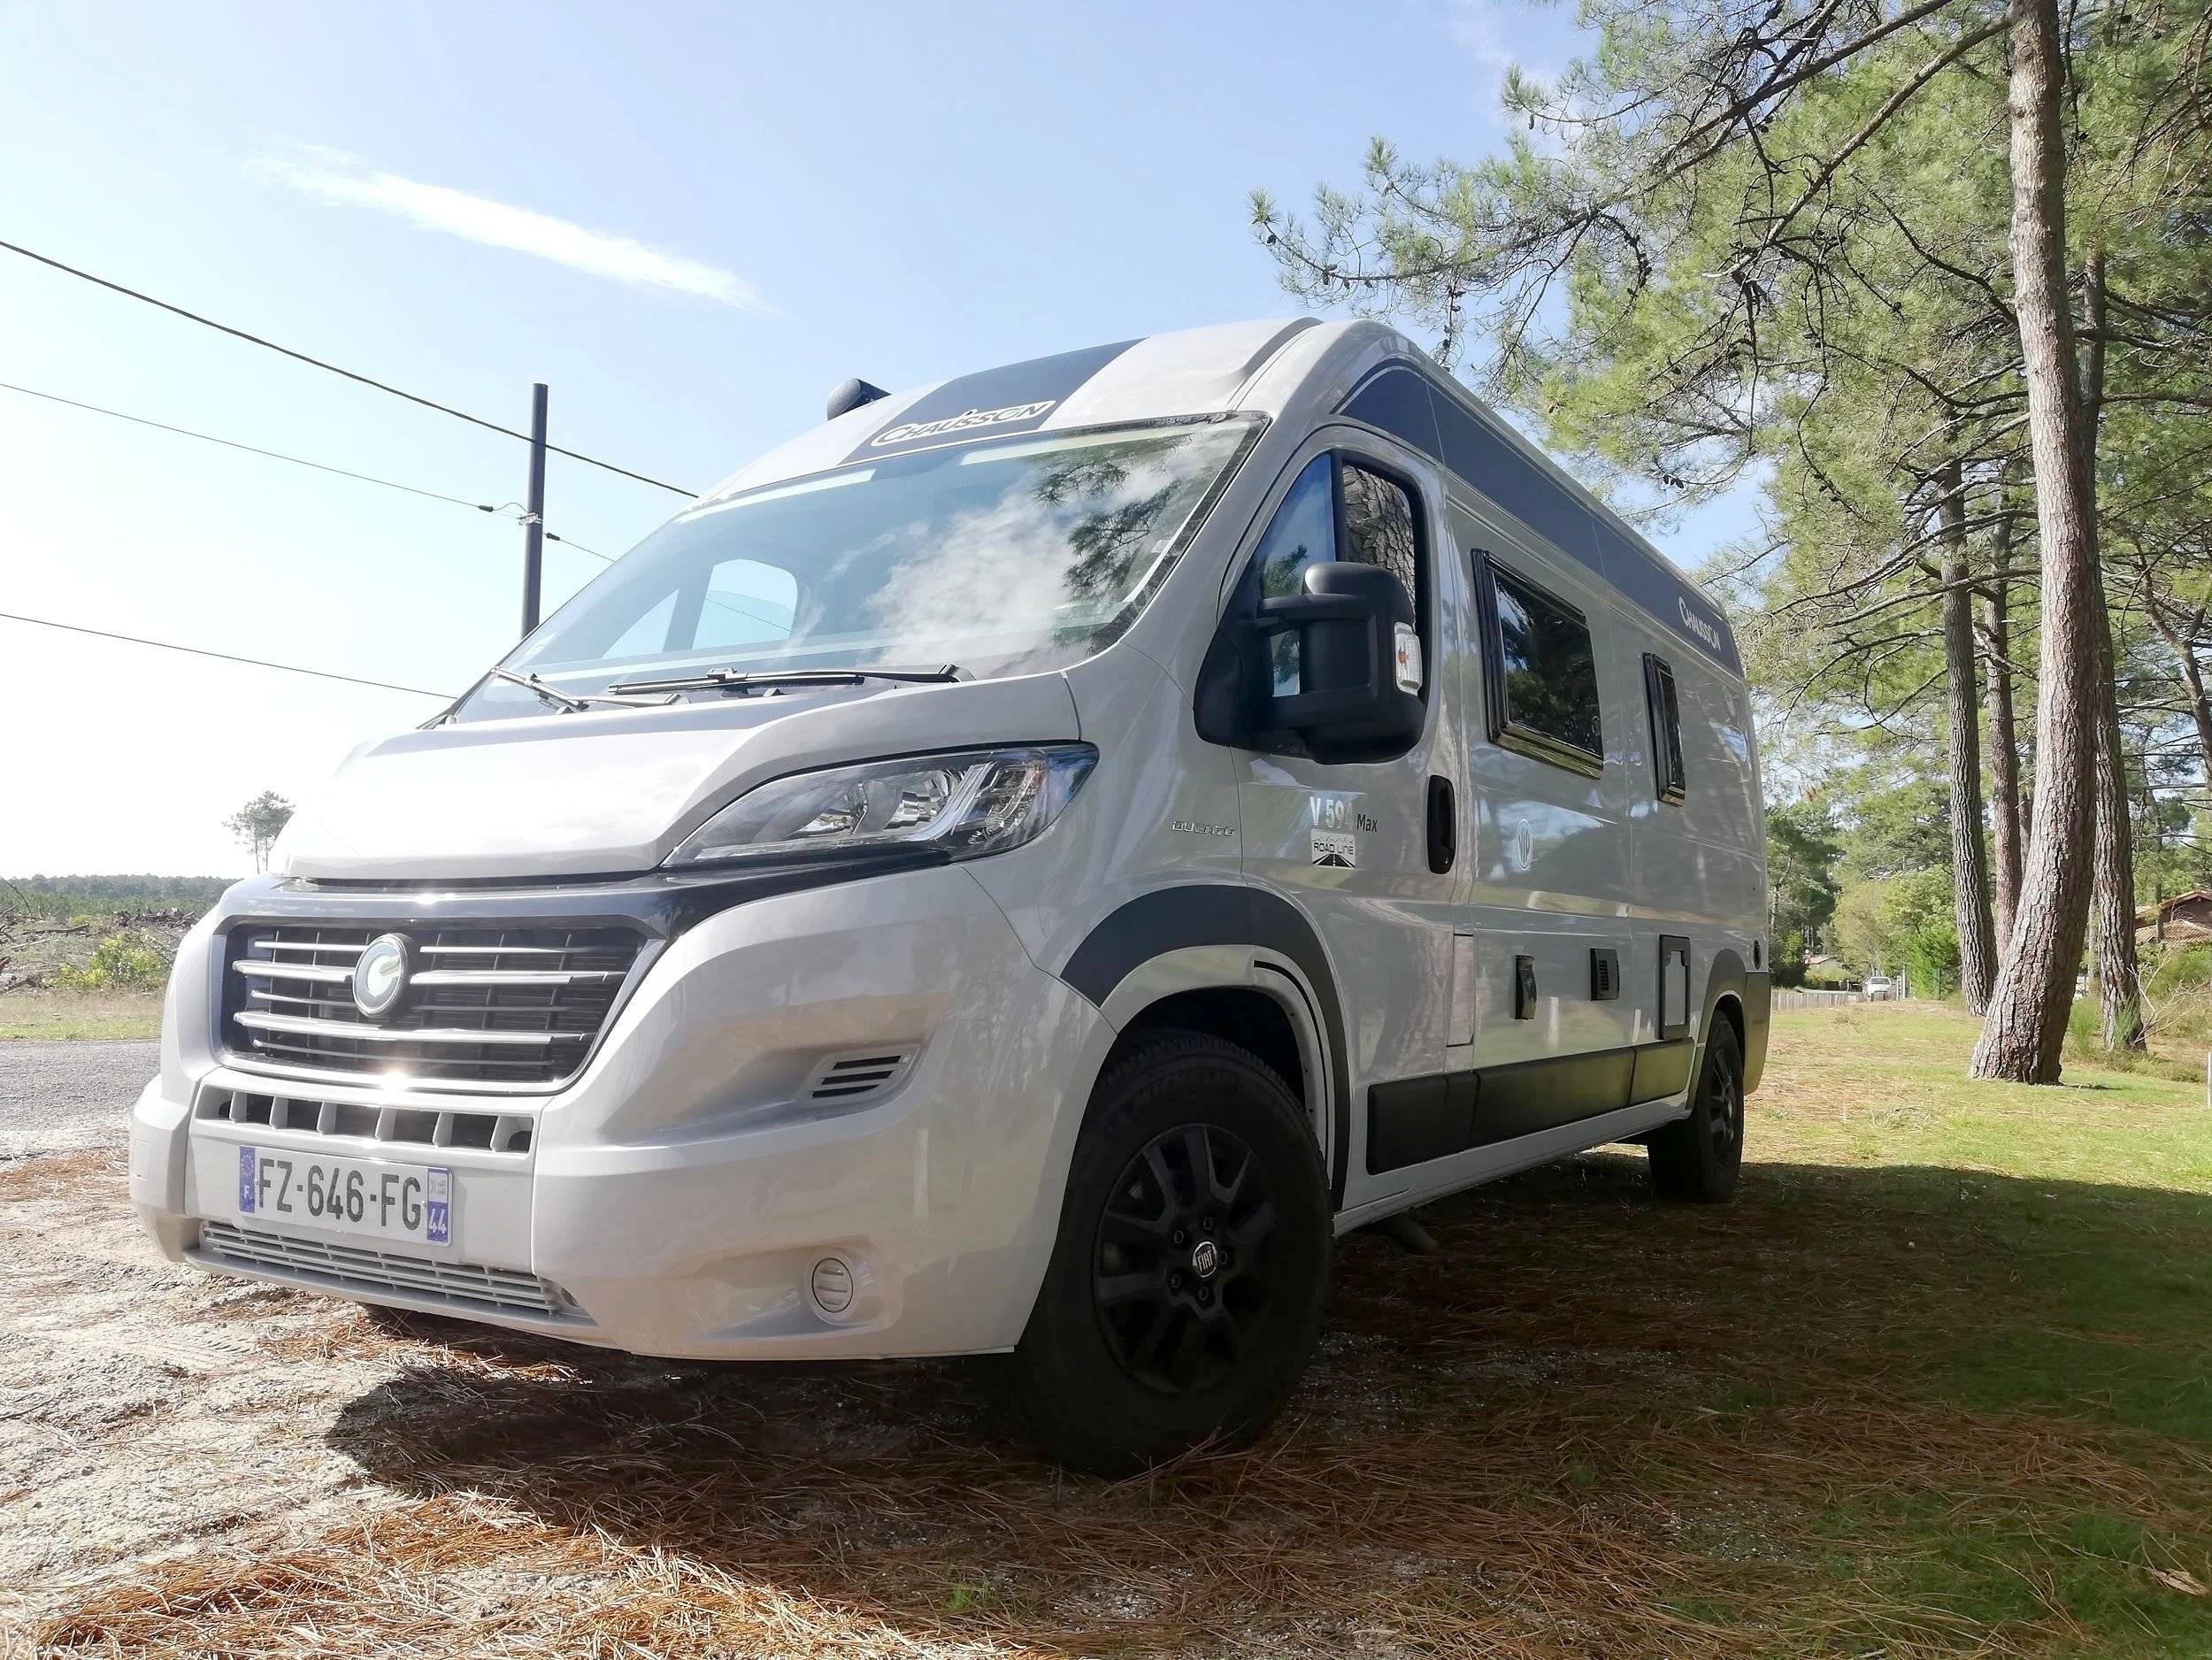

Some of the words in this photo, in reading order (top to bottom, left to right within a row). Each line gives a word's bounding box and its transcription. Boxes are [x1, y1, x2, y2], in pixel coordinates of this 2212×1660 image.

[877, 403, 1050, 442] CHAUSSON
[1310, 796, 1321, 826] V
[1356, 813, 1379, 833] Max
[1313, 842, 1335, 853] ROAD
[428, 1208, 447, 1234] 44
[1197, 1249, 1213, 1272] FIAT
